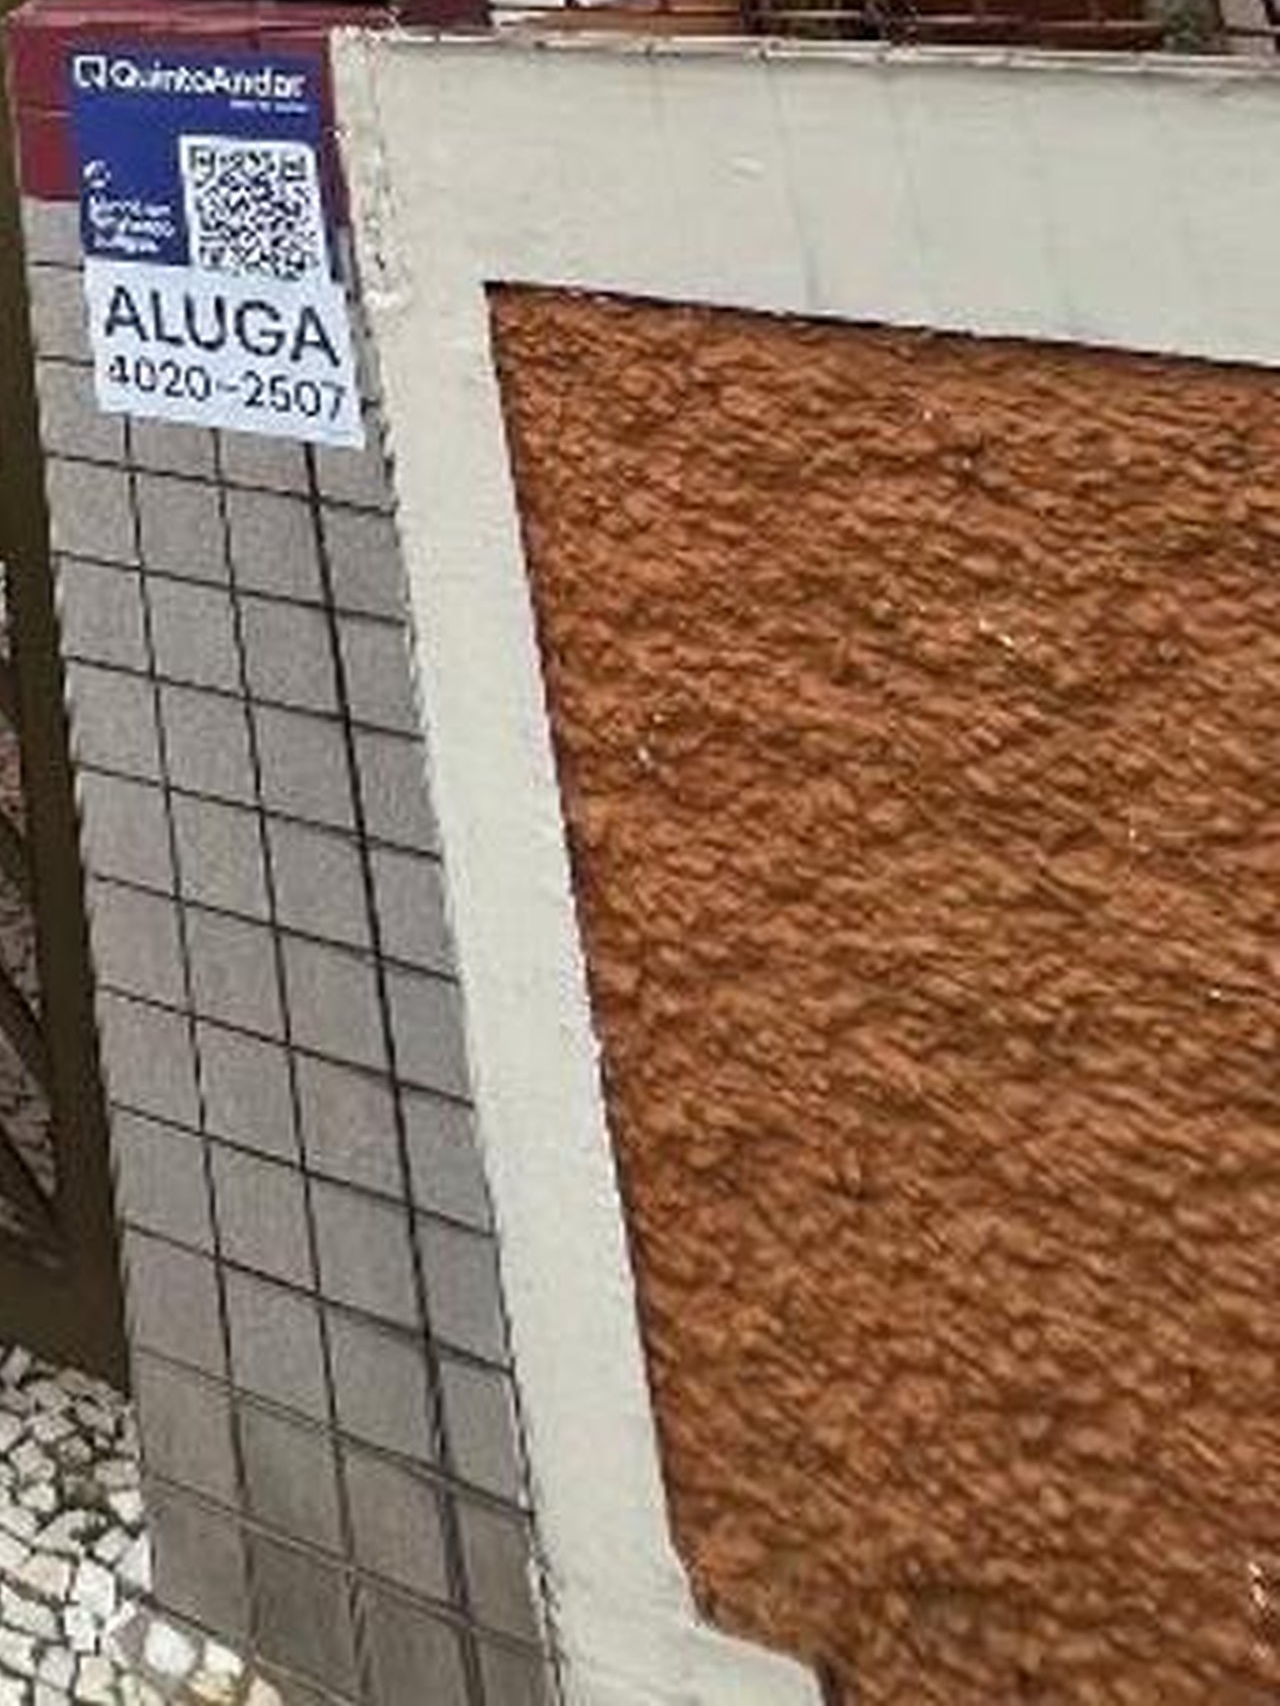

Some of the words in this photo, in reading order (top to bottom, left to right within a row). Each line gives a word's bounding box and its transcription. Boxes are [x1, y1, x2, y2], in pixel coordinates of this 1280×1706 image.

[109, 59, 307, 98] QuintoAndar
[104, 284, 341, 368] ALUGA
[108, 354, 347, 421] 4020-2507
